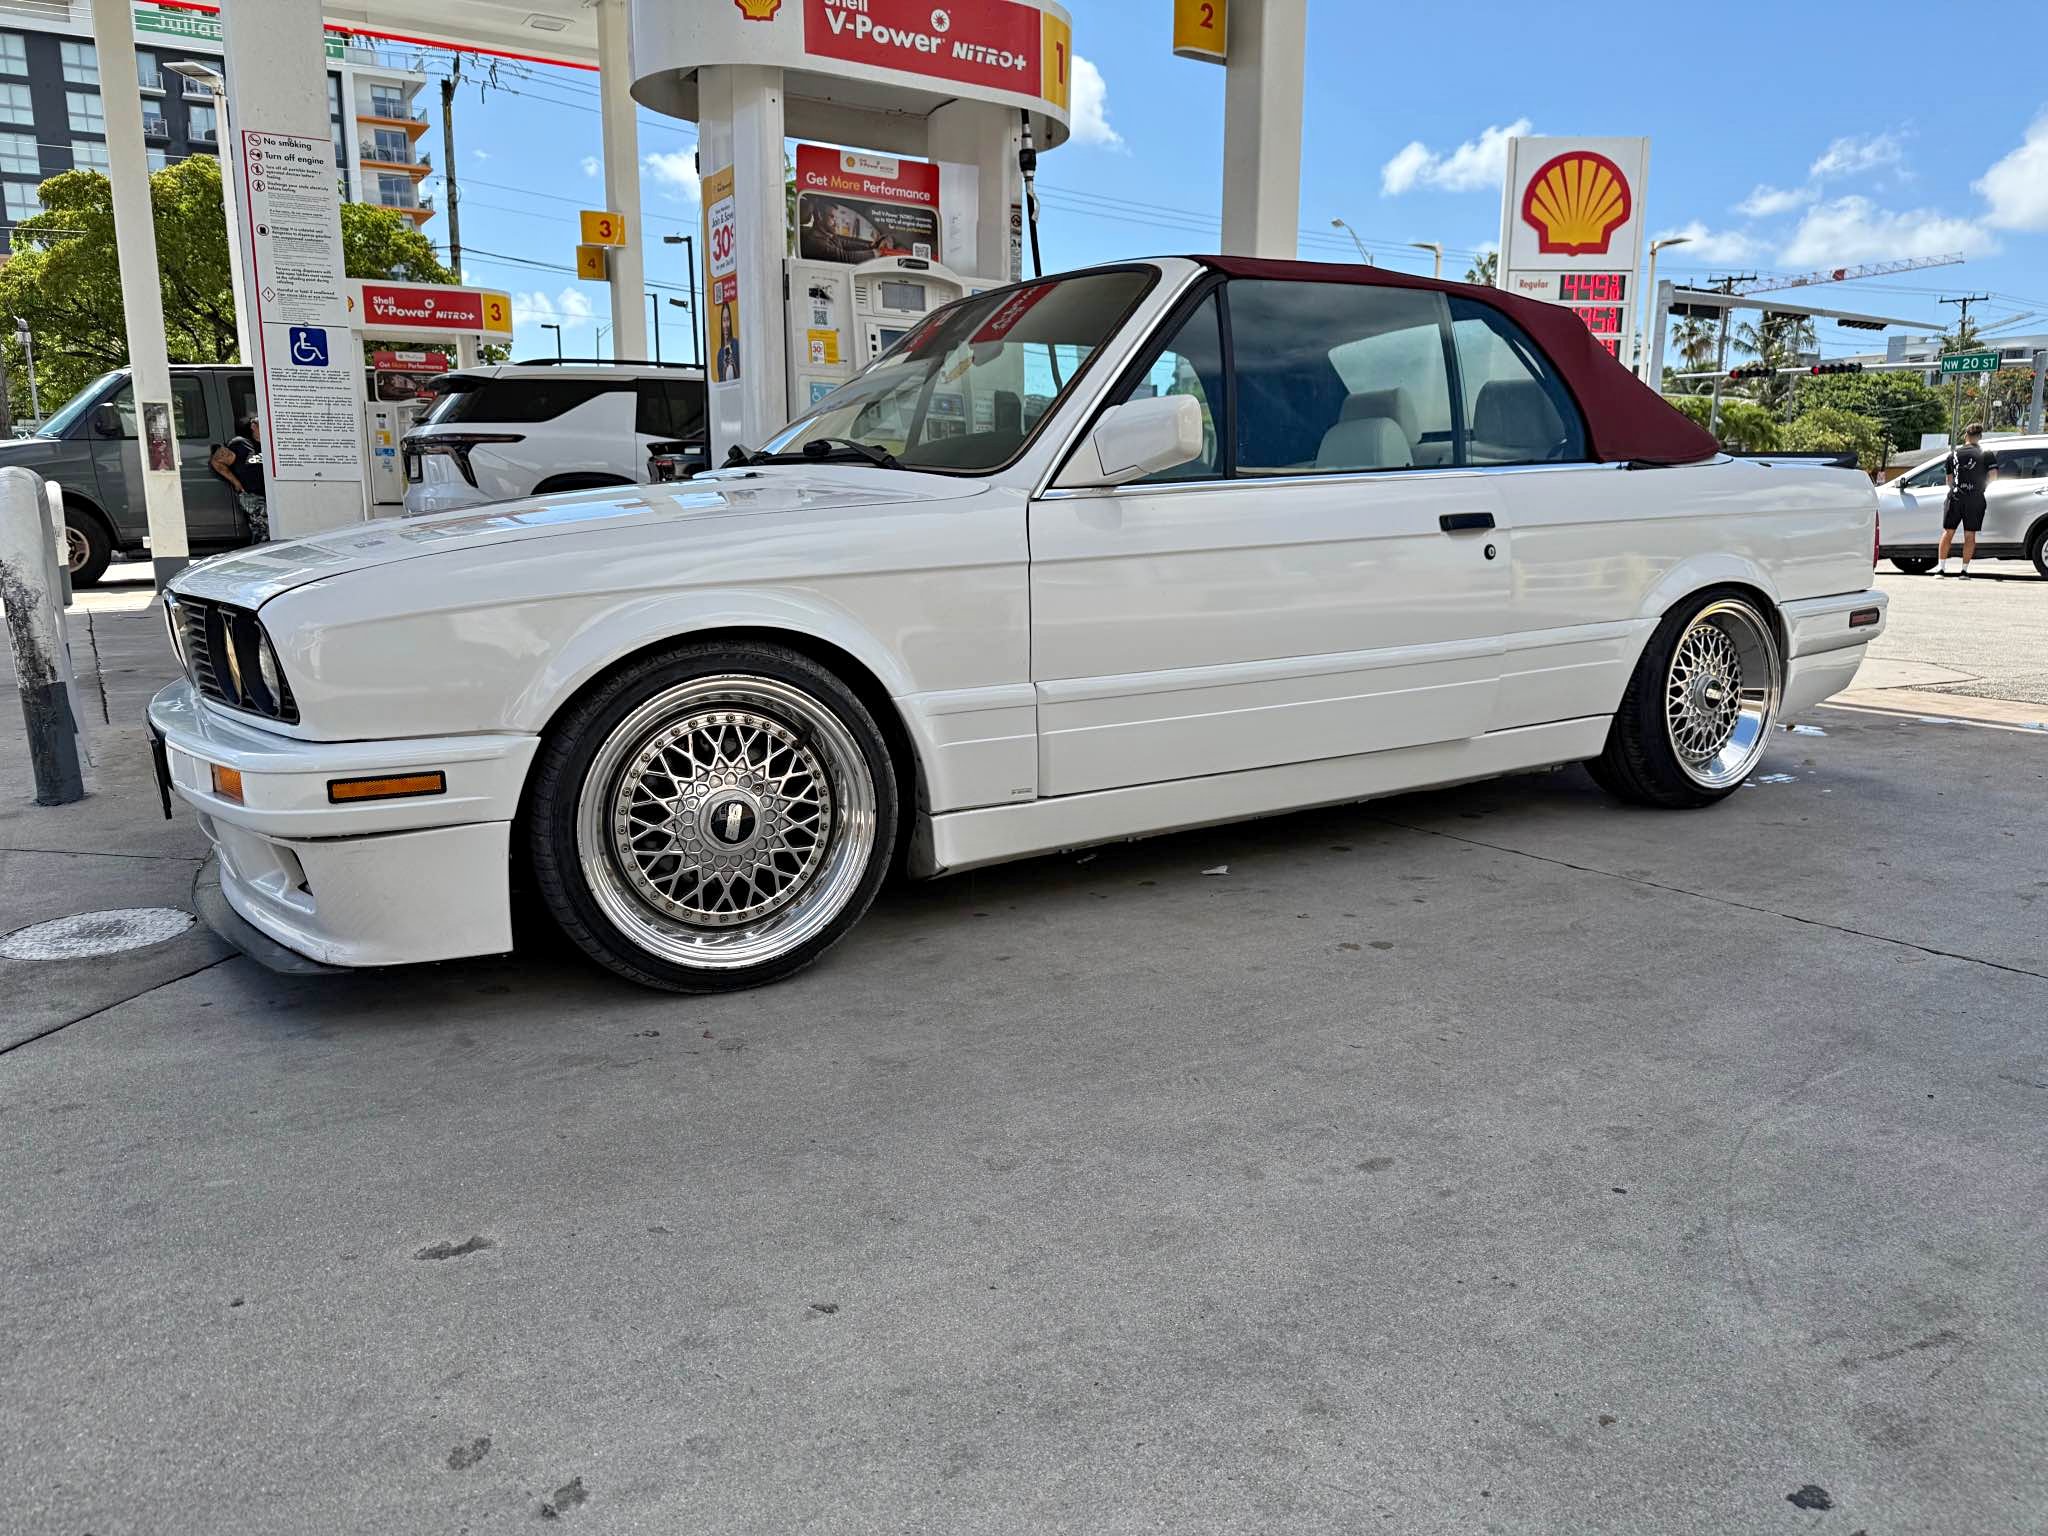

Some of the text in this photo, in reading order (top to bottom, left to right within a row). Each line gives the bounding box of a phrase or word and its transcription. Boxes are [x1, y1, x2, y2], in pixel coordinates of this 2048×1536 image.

[1200, 2, 1214, 29] 2
[825, 8, 1027, 71] V-Power NITRO+
[1056, 40, 1064, 85] 1
[263, 137, 312, 151] No smoking
[264, 152, 324, 166] Turn off engine
[806, 172, 931, 201] Get More Performance
[600, 219, 612, 238] 3
[587, 257, 596, 269] 4
[1519, 279, 1549, 291] Regular
[373, 296, 394, 305] Shell
[374, 304, 475, 321] V-Power NITRO+
[490, 303, 502, 321] 3
[1943, 357, 1995, 370] NW 20 ST
